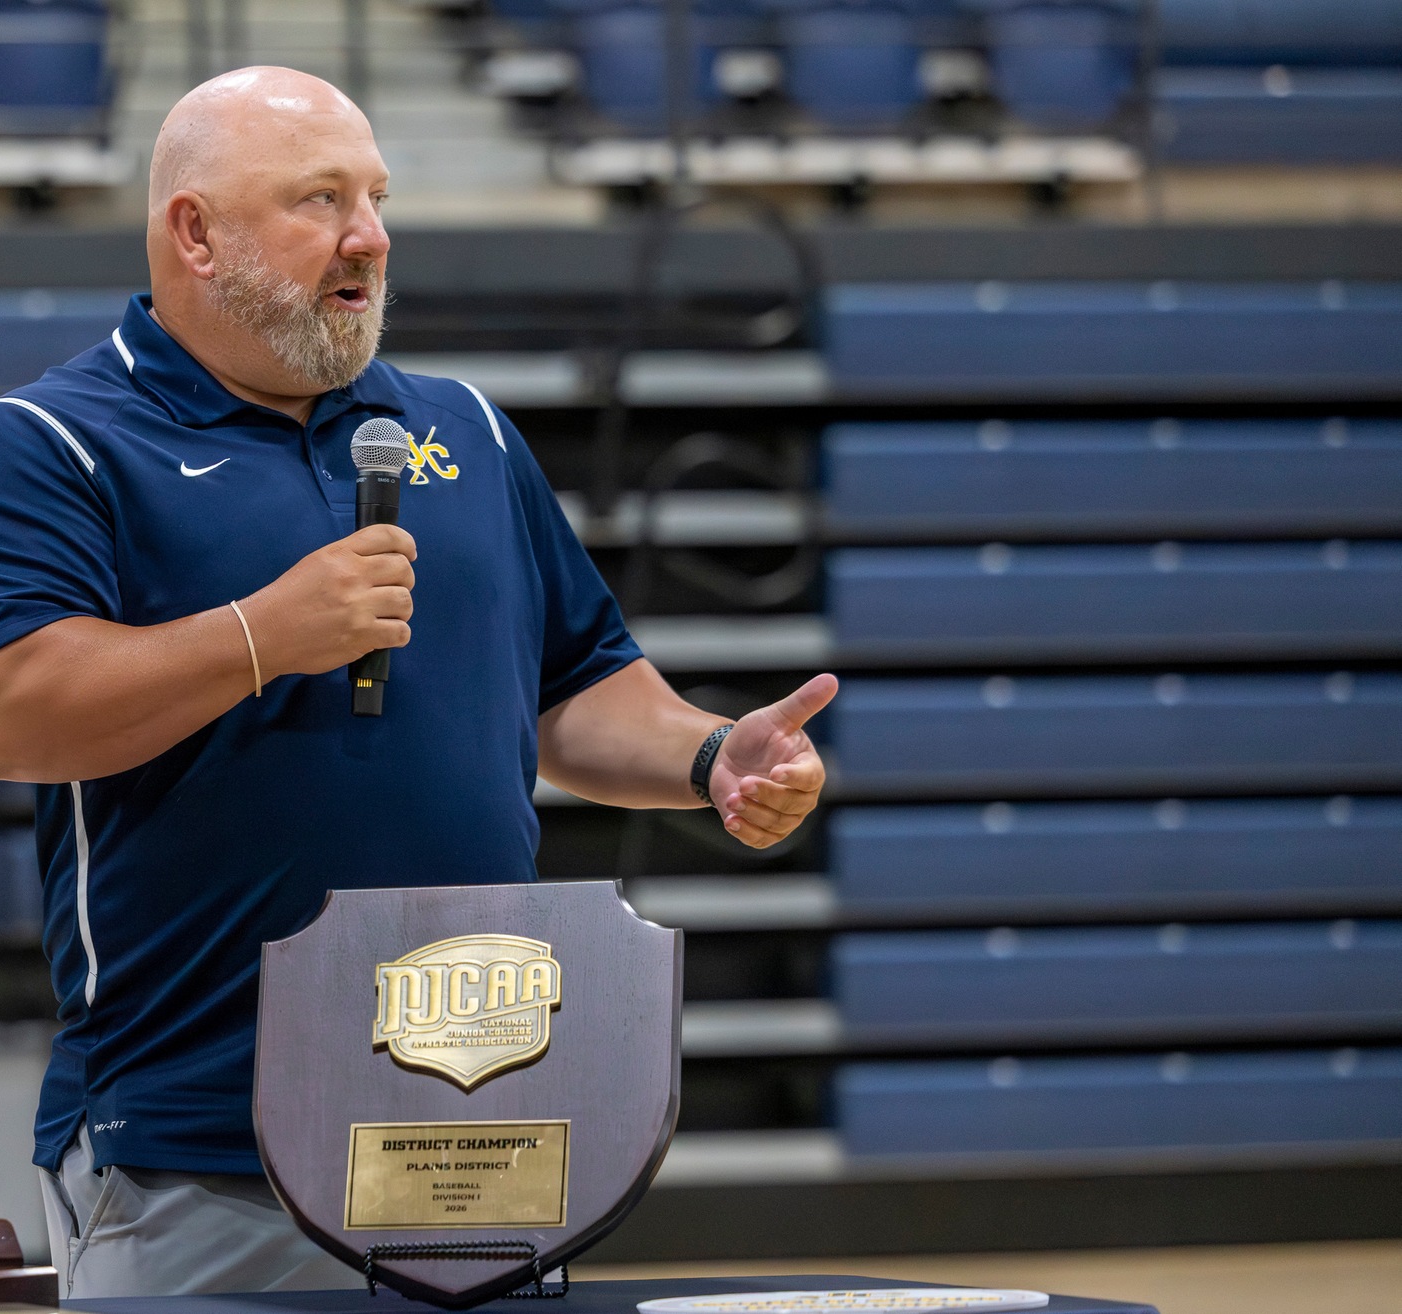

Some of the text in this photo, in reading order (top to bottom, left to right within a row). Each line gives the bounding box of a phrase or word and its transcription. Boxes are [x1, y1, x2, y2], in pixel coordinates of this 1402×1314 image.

[381, 963, 552, 1035] NJCAA
[480, 1018, 532, 1028] NATIONAL
[447, 1027, 532, 1038] JUNIOR COLLEGE
[412, 1036, 532, 1049] ATHLETIC ASSOCIATION
[382, 1138, 538, 1151] DISTRICT CHAMPION
[406, 1161, 510, 1172] PLAINS DISTRICT
